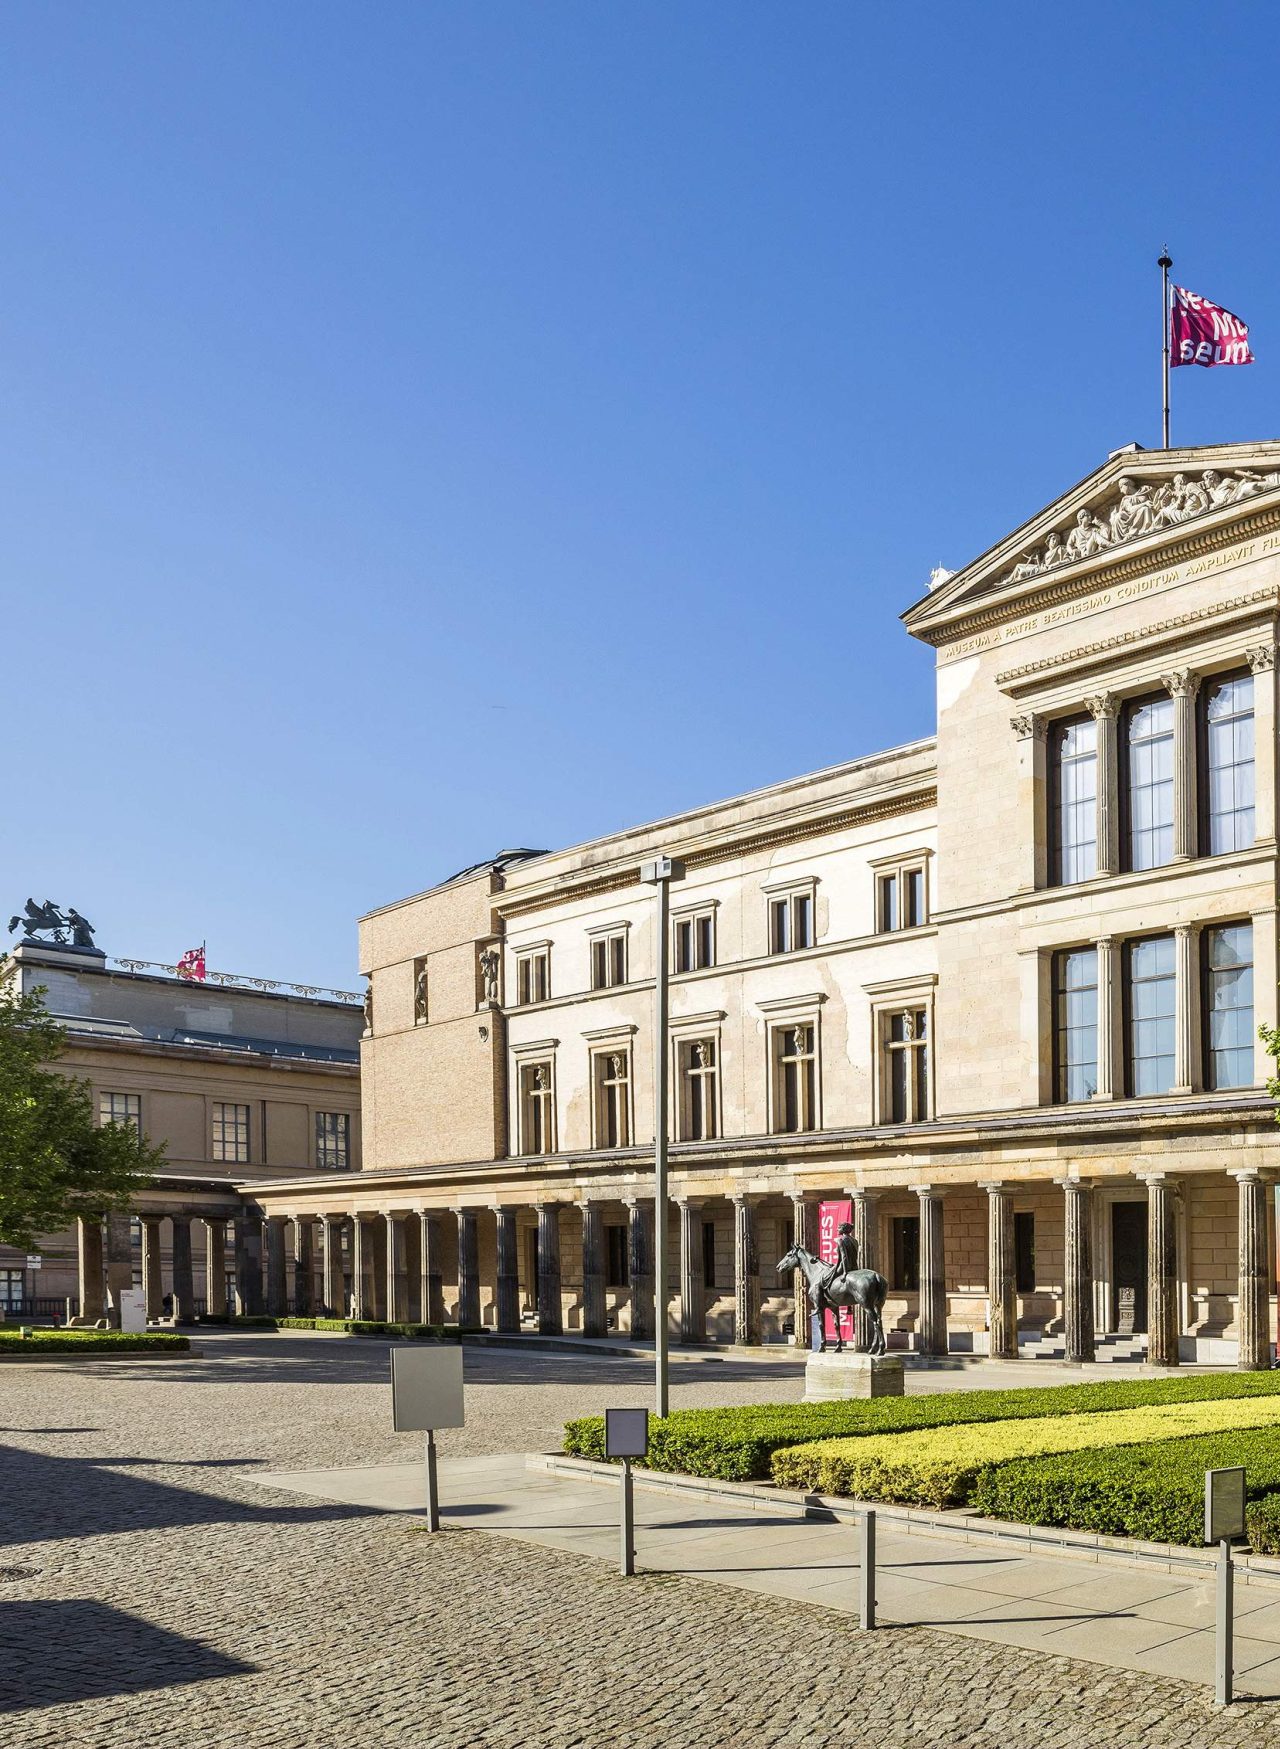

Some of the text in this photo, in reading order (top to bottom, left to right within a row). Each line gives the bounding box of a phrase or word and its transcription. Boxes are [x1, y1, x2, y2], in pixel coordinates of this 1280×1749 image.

[945, 635, 991, 658] MUSEUM
[993, 630, 1002, 642] A
[1005, 618, 1038, 638] PATRE
[1043, 594, 1112, 624] BEATISSIMO
[1117, 570, 1179, 599] CONDITUM
[1186, 544, 1256, 577] AMPLIAVIT
